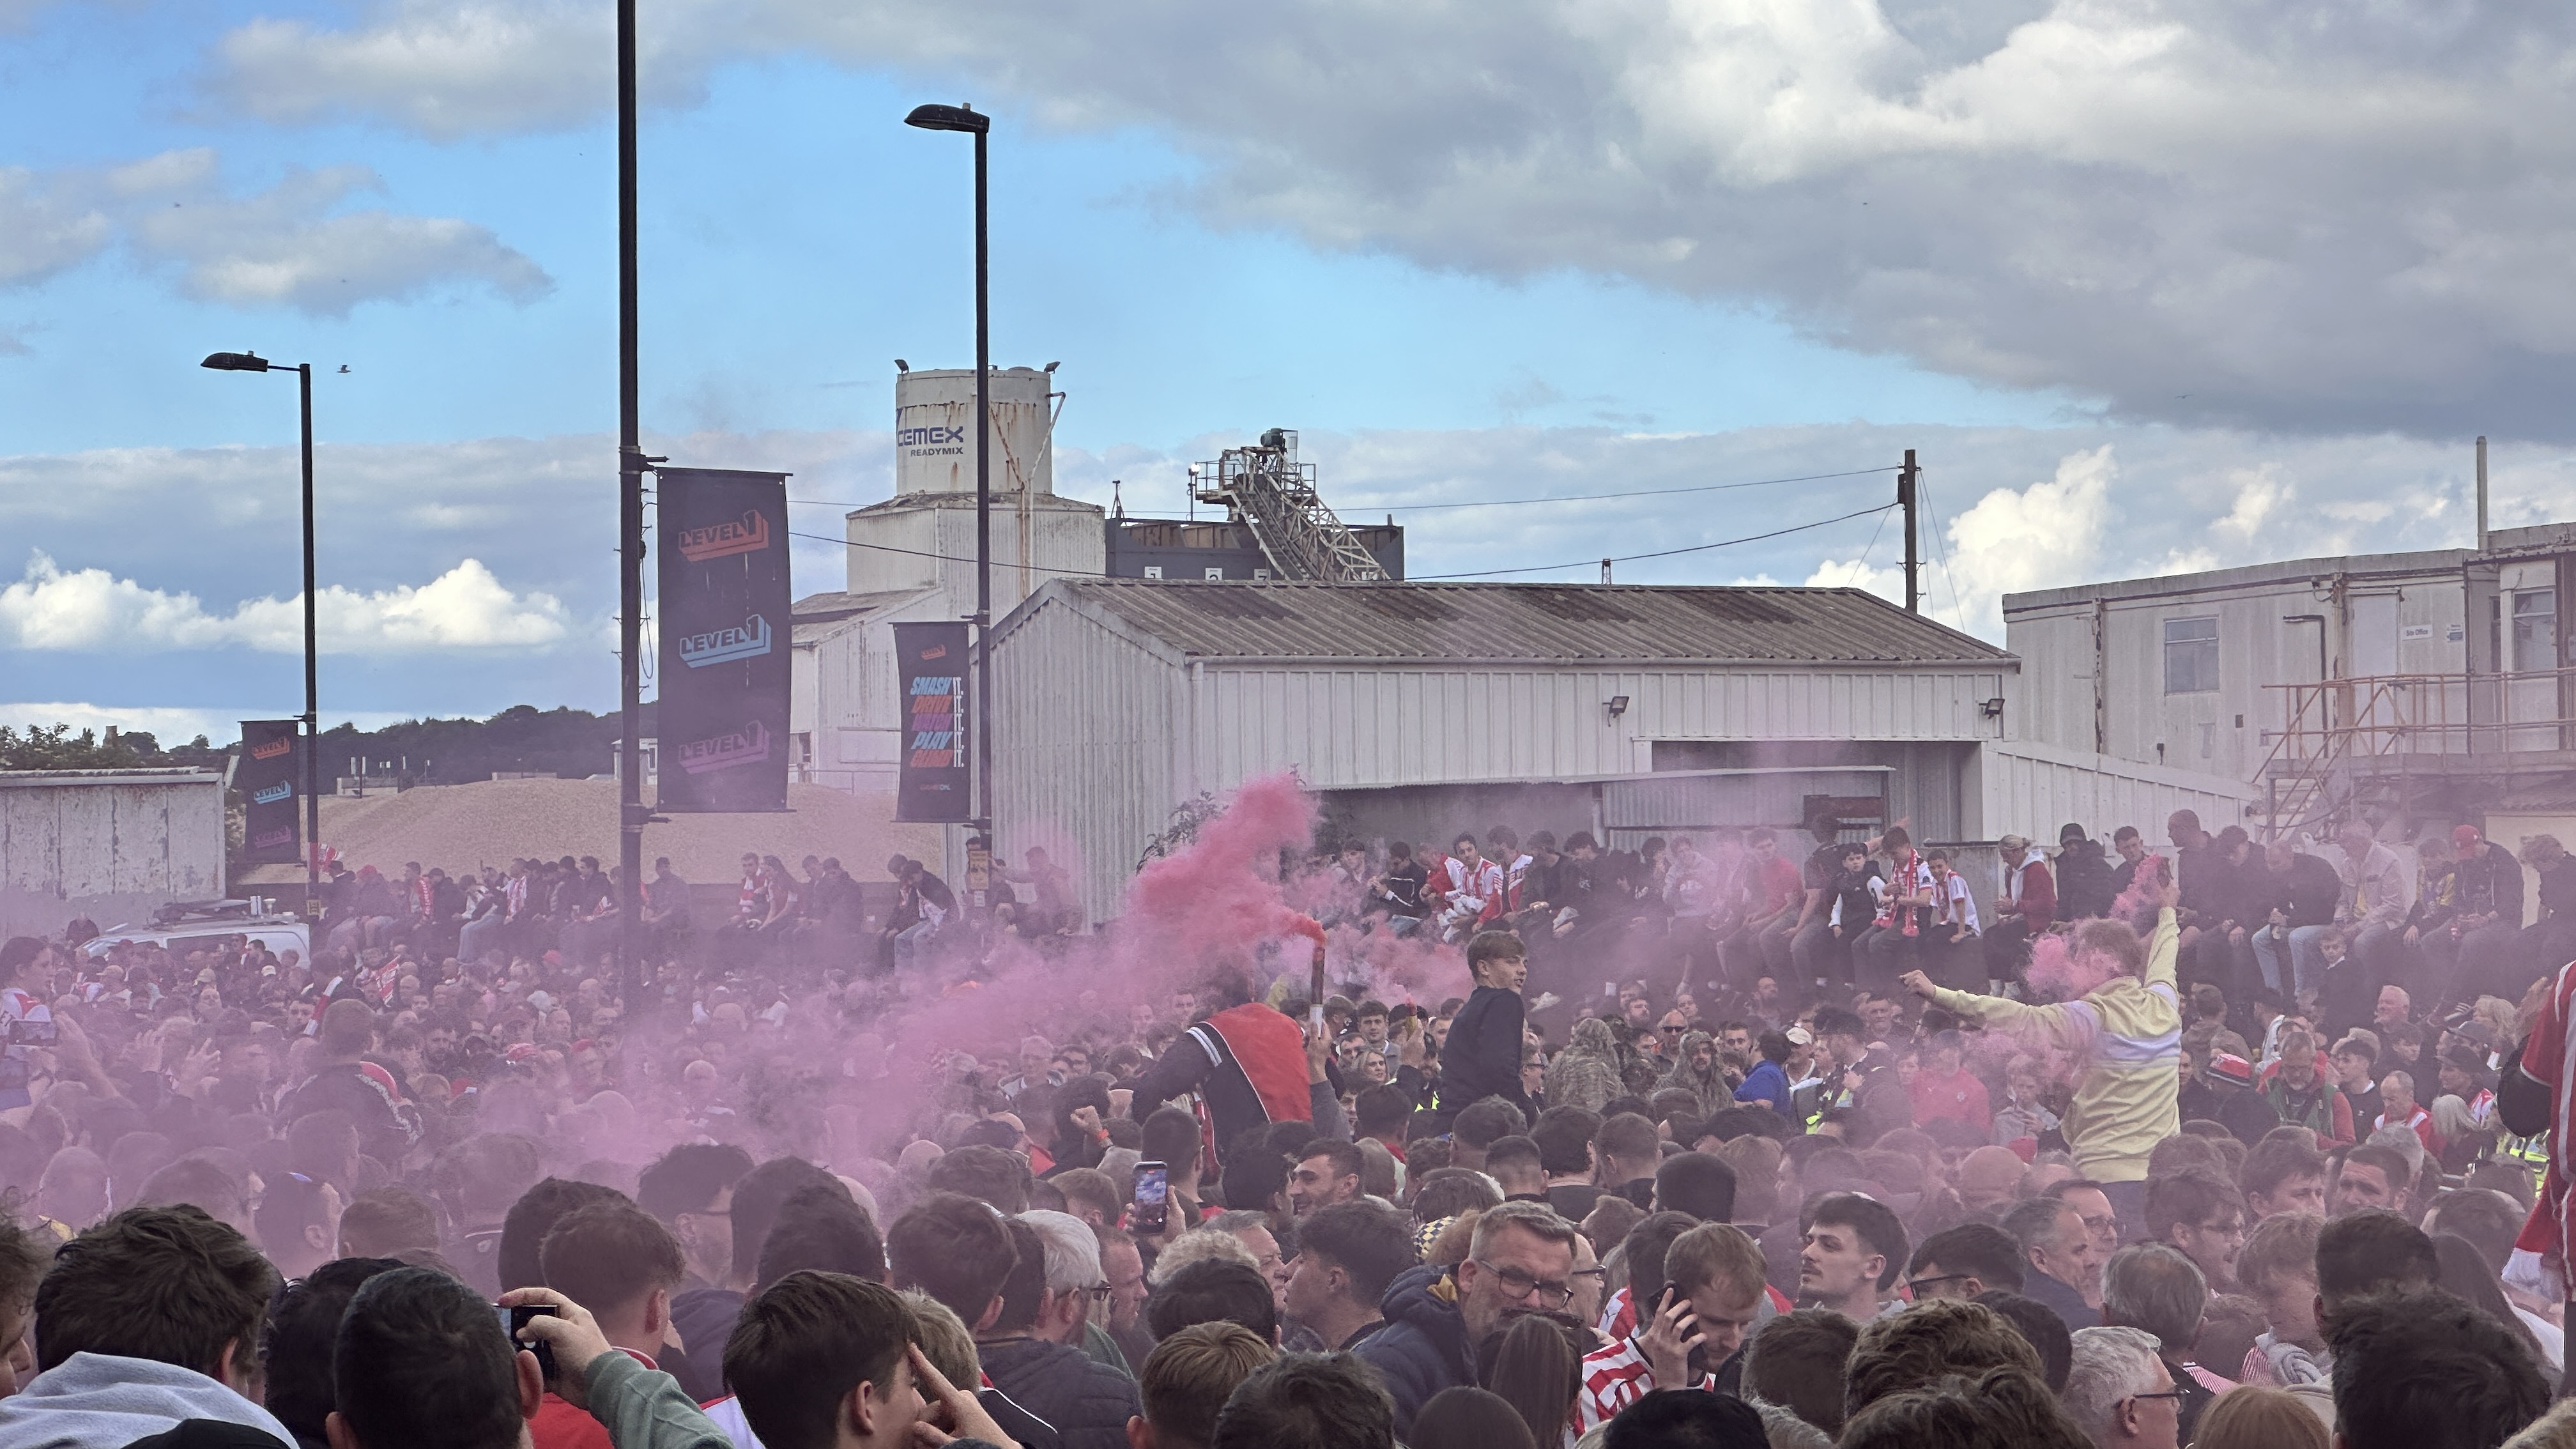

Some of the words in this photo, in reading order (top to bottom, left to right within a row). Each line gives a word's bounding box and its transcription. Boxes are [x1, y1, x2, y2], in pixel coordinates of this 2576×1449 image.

[898, 426, 963, 447] CEMEX
[910, 447, 963, 457] READYMIX
[910, 677, 952, 695] SMASH
[953, 677, 964, 695] IT.
[911, 695, 953, 714] DRIVE
[953, 695, 964, 714] IT.
[953, 713, 964, 732] IT.
[910, 731, 954, 749] PLAY
[954, 731, 964, 749] IT.
[954, 749, 964, 767] IT.
